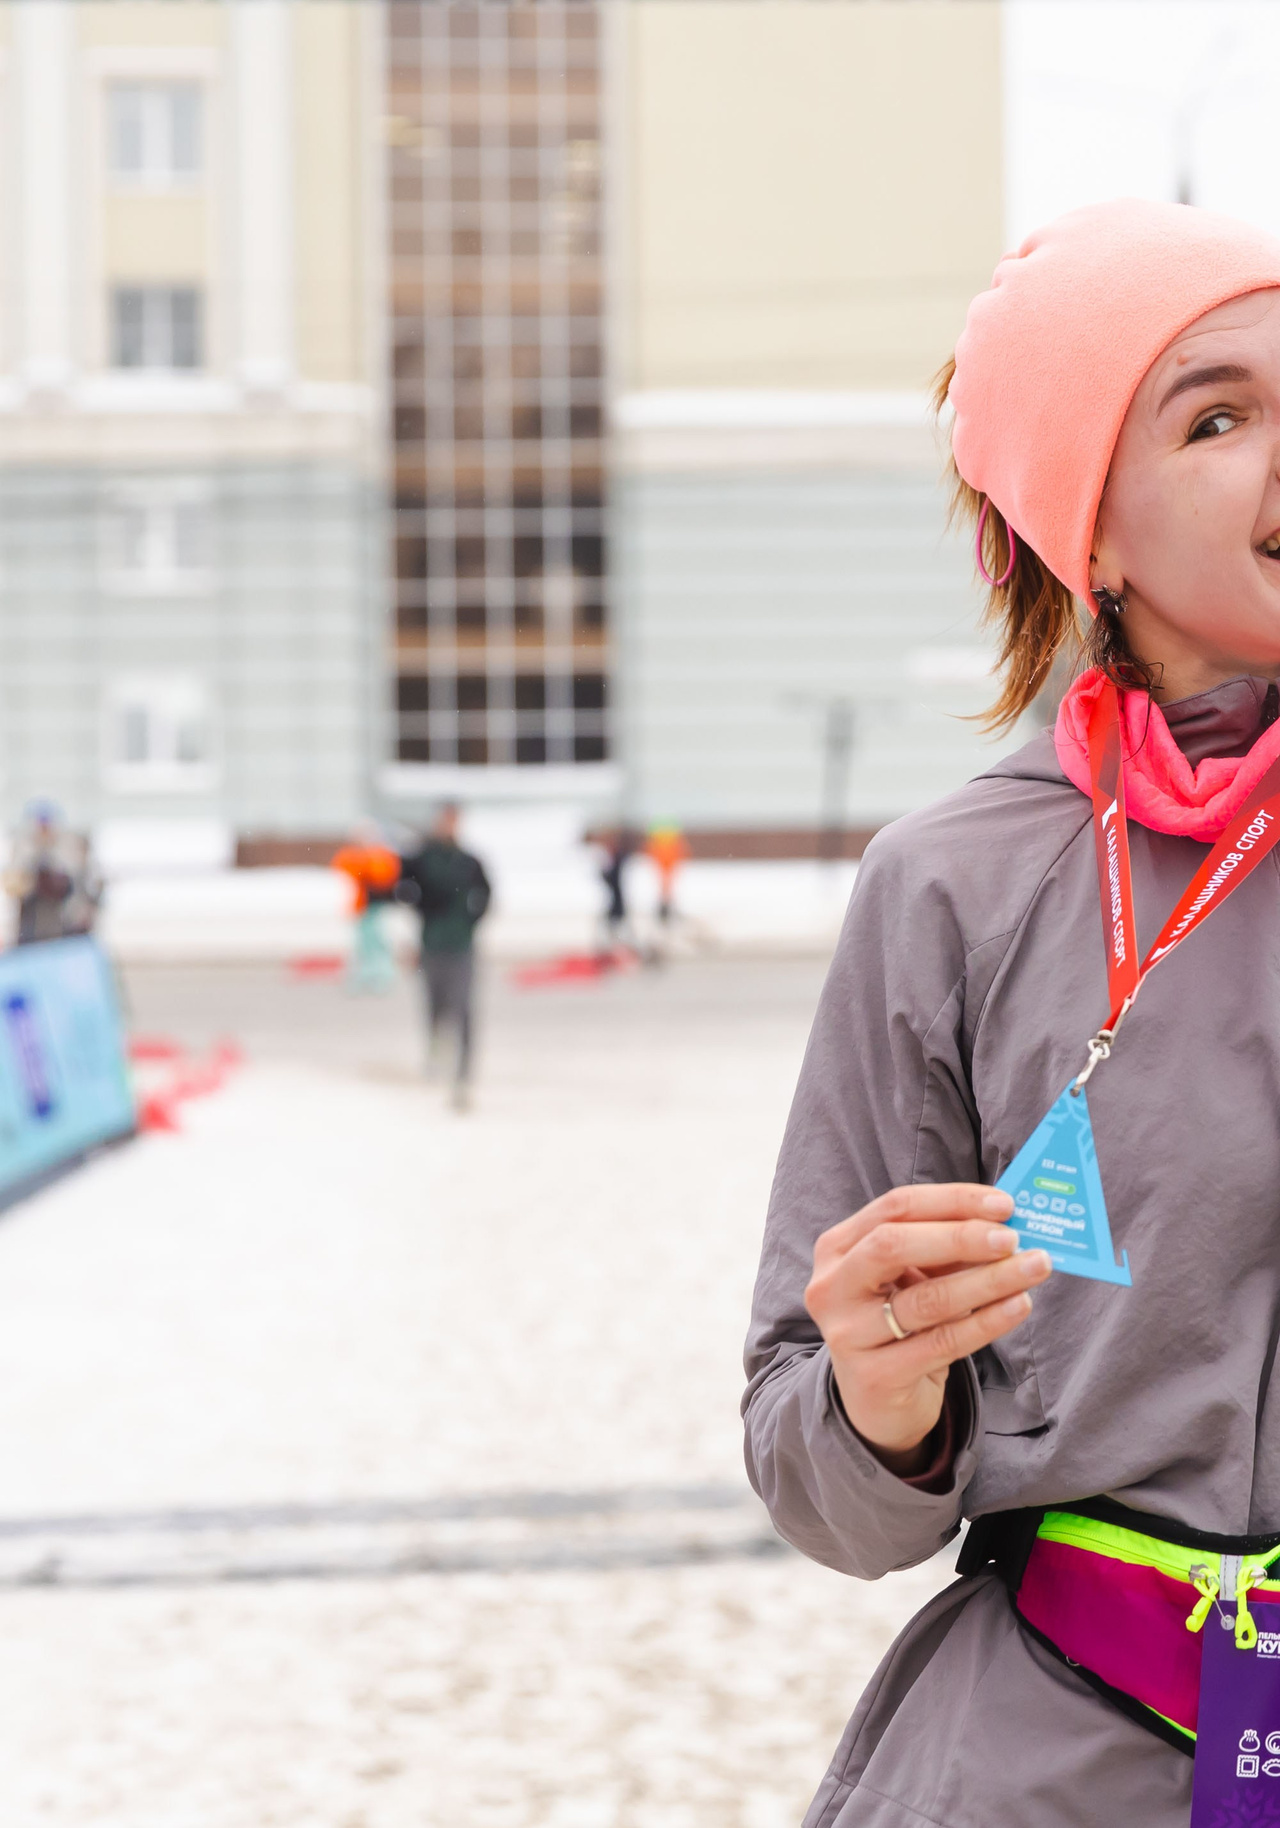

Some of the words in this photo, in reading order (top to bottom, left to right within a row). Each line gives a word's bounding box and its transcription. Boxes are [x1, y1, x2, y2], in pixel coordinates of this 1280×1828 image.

[1106, 825, 1122, 922] КАЛАШНИКОВ
[1169, 852, 1244, 938] КАЛАШНИКОВ
[1236, 809, 1274, 851] СПОРТ
[1113, 920, 1126, 968] СПОРТ
